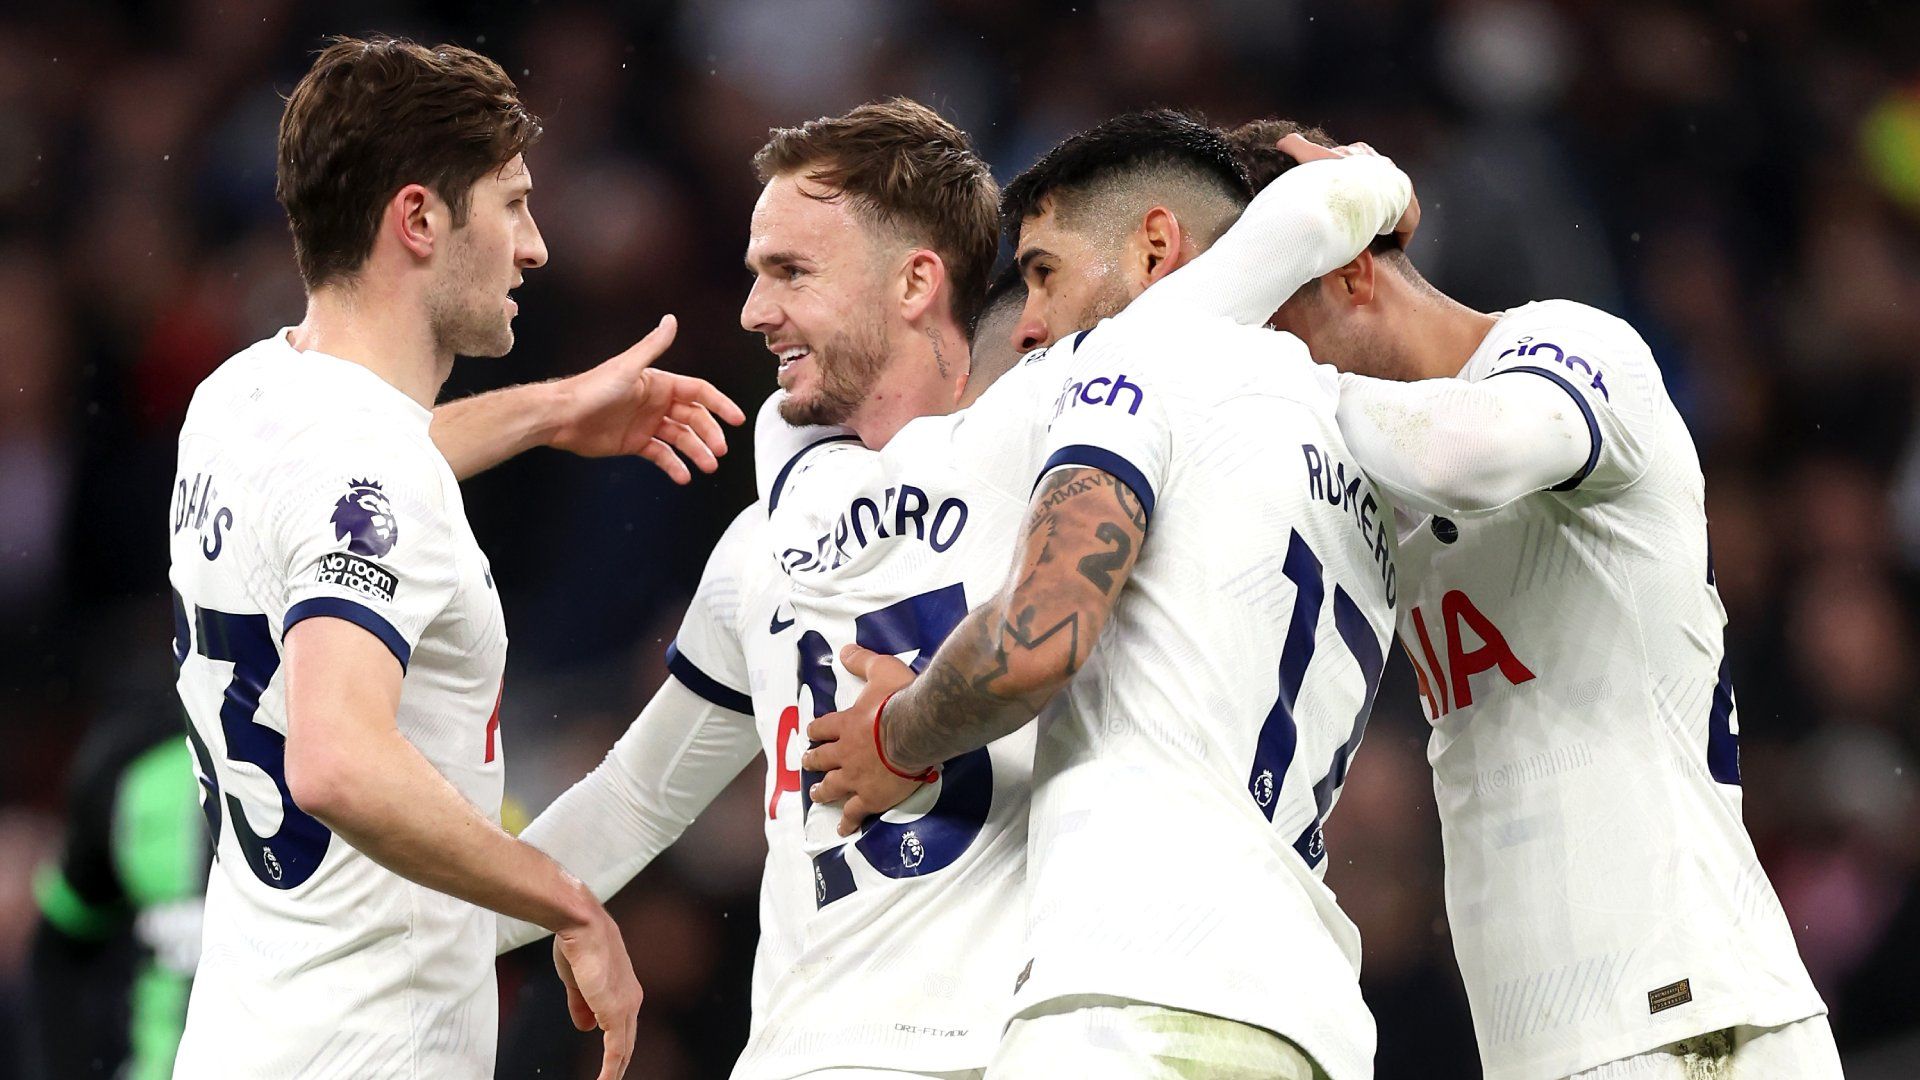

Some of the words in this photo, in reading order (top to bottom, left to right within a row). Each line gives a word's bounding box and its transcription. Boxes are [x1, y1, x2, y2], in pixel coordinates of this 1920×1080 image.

[319, 553, 346, 573] No
[347, 559, 392, 592] room
[1301, 443, 1397, 609] ROMERO
[341, 572, 392, 604] racism
[1247, 525, 1385, 871] 17
